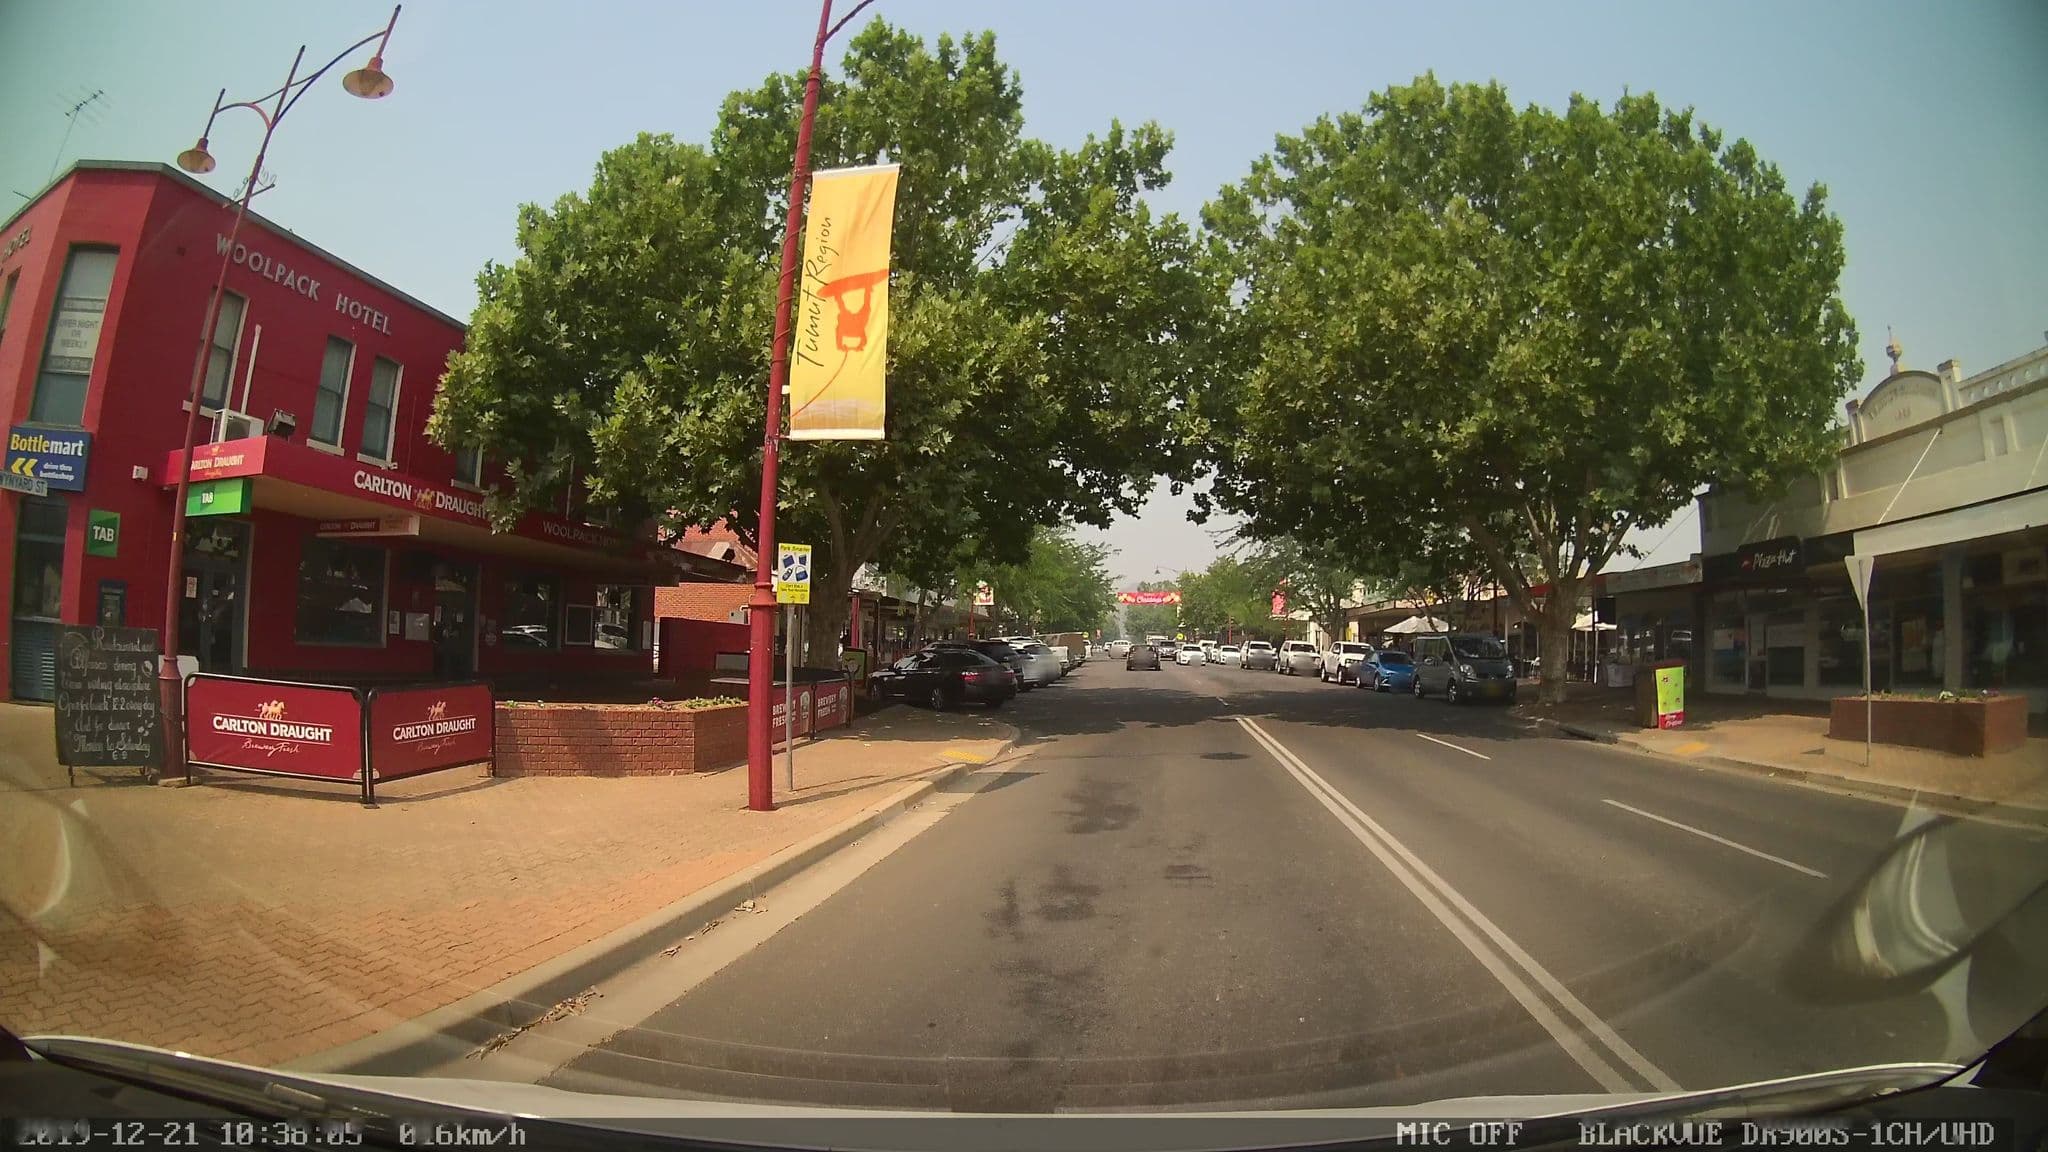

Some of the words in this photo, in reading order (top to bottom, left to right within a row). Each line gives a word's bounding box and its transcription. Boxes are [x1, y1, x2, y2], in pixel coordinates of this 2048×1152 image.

[805, 216, 840, 286] Region
[216, 232, 321, 301] WOOLPACK
[335, 293, 392, 336] HOTEL
[796, 287, 826, 367] Tumut
[10, 433, 85, 456] Bottlemart
[190, 459, 213, 471] ARLTON
[36, 480, 46, 493] ST
[354, 470, 412, 501] CARLTON
[435, 490, 488, 520] DRAUGHT
[93, 525, 115, 542] TAB
[213, 715, 267, 735] CARLTON
[270, 722, 333, 741] DRAUGHT
[393, 725, 434, 740] CARLTON
[436, 718, 476, 734] DRAUGHT
